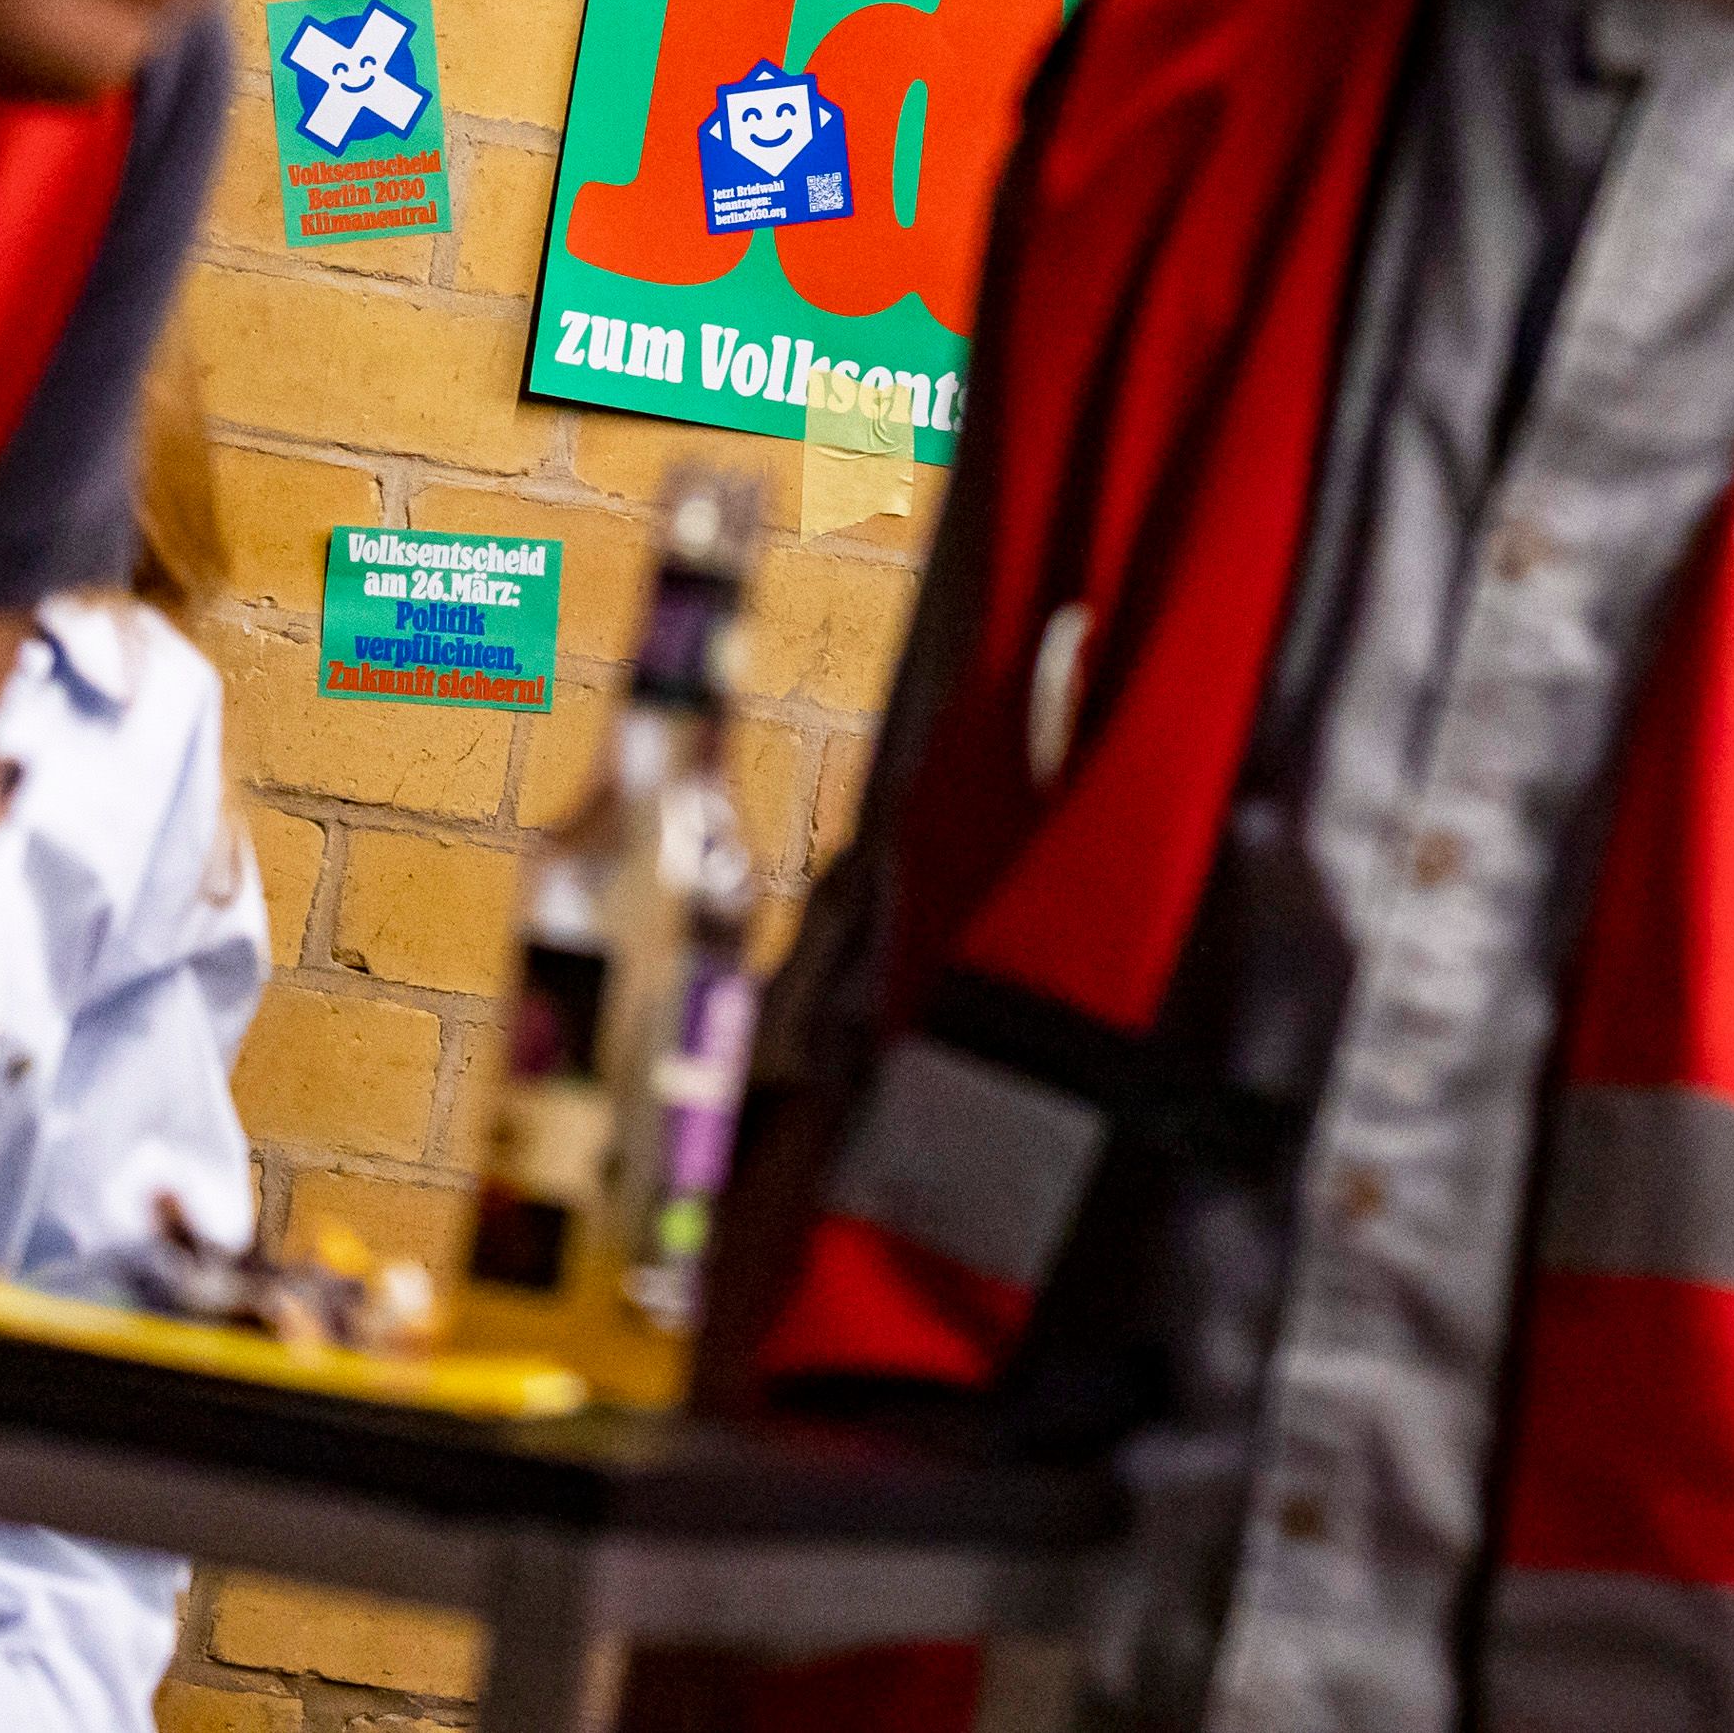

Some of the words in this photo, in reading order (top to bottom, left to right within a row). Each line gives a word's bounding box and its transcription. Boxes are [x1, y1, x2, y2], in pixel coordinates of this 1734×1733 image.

[288, 150, 442, 187] Volksentscheid
[307, 182, 371, 211] Berlin
[374, 177, 425, 204] 2030
[713, 187, 734, 200] Jetzt
[736, 180, 785, 197] Briefwahl
[714, 196, 772, 212] beantragen:
[300, 201, 438, 236] Klimaneutral
[715, 207, 787, 226] berlin2030.org
[554, 310, 686, 384] zum
[700, 322, 965, 432] Volksent
[348, 532, 547, 576] Volksentscheid
[363, 572, 407, 598] am
[395, 601, 486, 636] Politik
[354, 633, 523, 676] verpflichten,
[326, 660, 436, 697] Zukunft
[437, 668, 545, 705] sichern!
